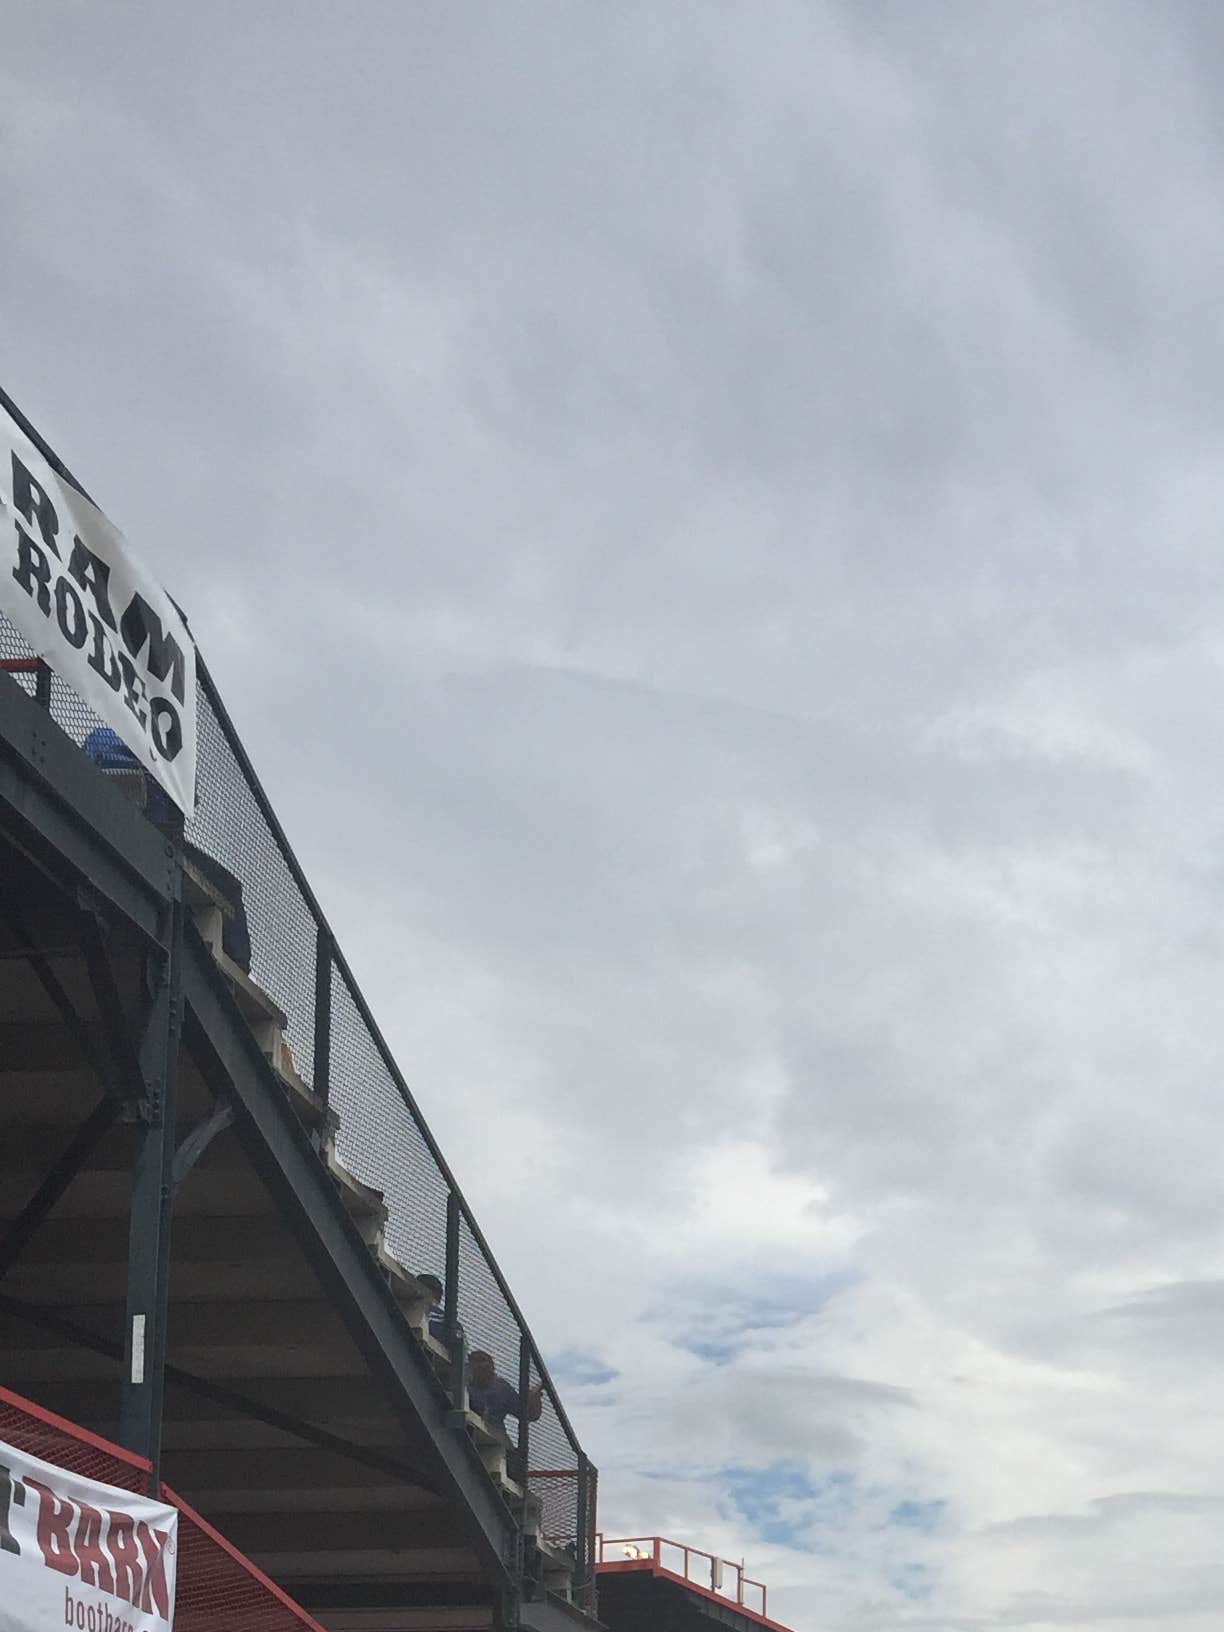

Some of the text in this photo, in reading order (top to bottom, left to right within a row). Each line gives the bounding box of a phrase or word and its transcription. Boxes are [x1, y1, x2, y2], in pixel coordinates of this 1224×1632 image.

[11, 449, 186, 708] RAM
[12, 518, 183, 762] RODEO
[22, 1475, 169, 1622] BARN
